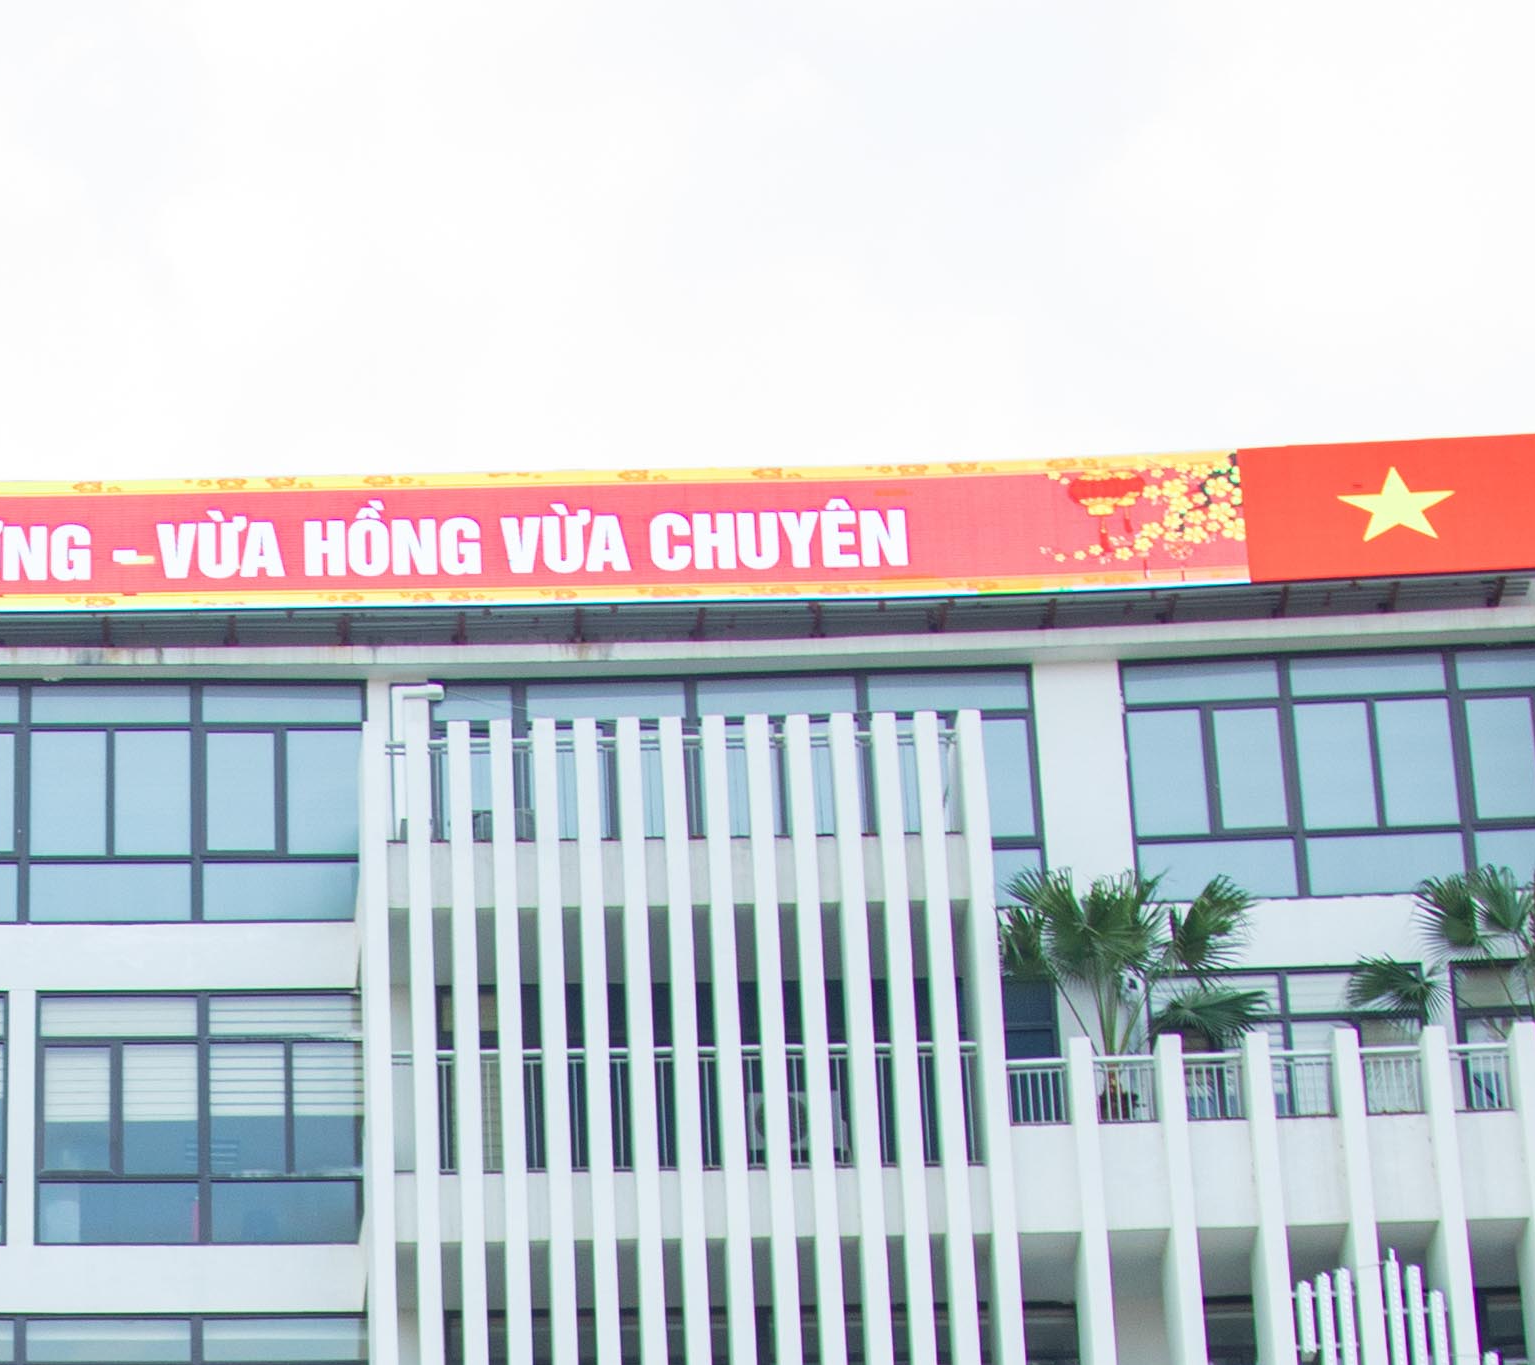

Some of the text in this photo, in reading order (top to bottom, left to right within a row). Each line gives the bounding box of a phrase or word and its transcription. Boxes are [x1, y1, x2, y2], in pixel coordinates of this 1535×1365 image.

[302, 499, 483, 577] HỒNG
[501, 502, 632, 575] VỪA
[648, 499, 910, 571] CHUYÊN
